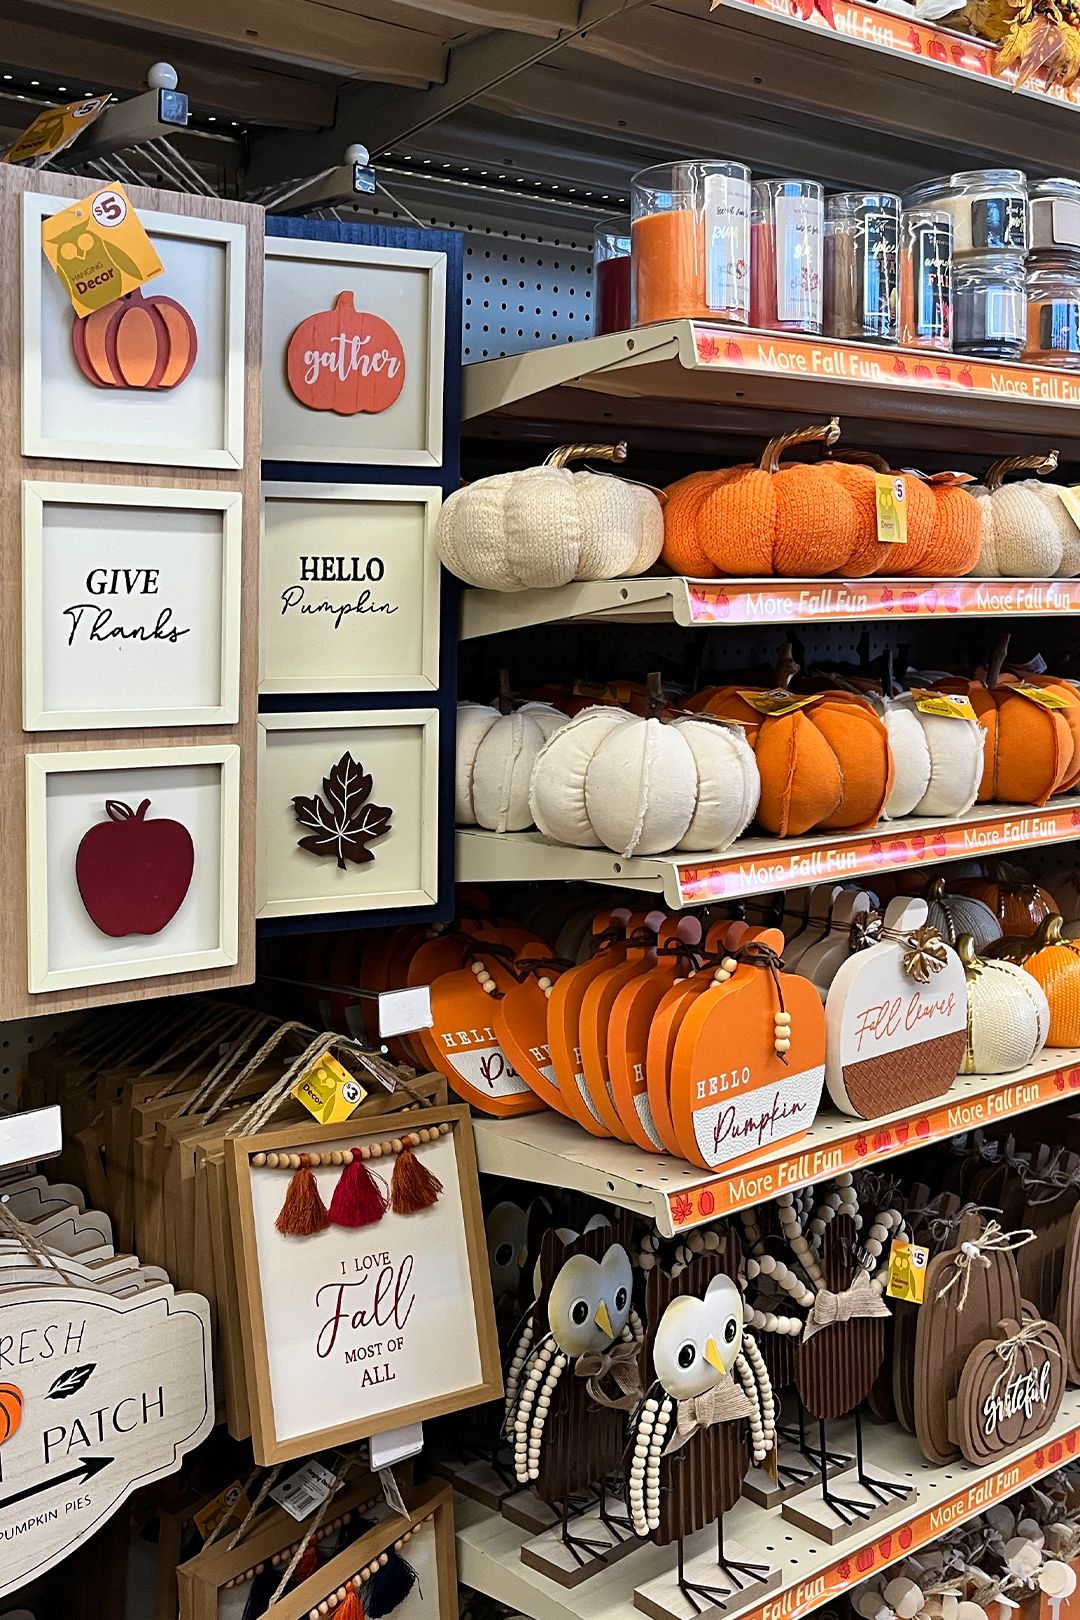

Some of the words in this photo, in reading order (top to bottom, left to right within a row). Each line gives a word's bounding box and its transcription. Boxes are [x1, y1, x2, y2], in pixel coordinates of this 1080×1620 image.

[834, 10, 858, 36] all
[863, 17, 894, 47] Fun
[94, 196, 122, 220] $5
[71, 261, 104, 282] HANGING
[75, 268, 115, 295] Decor
[304, 333, 400, 385] gather
[757, 344, 807, 371] More
[811, 350, 845, 374] Fall
[850, 356, 881, 378] Fun
[990, 373, 1029, 397] More
[1032, 377, 1058, 399] Fall
[86, 569, 160, 595] GIVE
[300, 556, 385, 582] HELLO
[280, 585, 399, 630] Pumpkin
[746, 592, 792, 615] More
[798, 590, 831, 614] Fall
[836, 590, 868, 613] Fun
[976, 589, 1013, 610] More
[1016, 588, 1043, 609] Fall
[1046, 588, 1070, 611] Fun
[63, 604, 191, 647] Thanks
[963, 829, 1000, 850] More
[1003, 822, 1031, 843] Fall
[1033, 818, 1056, 839] Fun
[738, 864, 785, 888] More
[789, 855, 822, 879] Fall
[827, 850, 857, 871] Fun
[441, 1027, 497, 1048] HELL
[855, 997, 902, 1051] Fall
[302, 1083, 324, 1106] Decor
[346, 1083, 359, 1101] $3
[696, 1066, 750, 1100] HELLO
[947, 1104, 984, 1127] More
[987, 1092, 1014, 1117] Fall
[1016, 1083, 1040, 1106] Fun
[713, 1091, 807, 1154] Pumpkin
[728, 1171, 773, 1204] More
[777, 1155, 809, 1187] Fall
[813, 1147, 843, 1173] Fun
[340, 1261, 347, 1275] I
[354, 1252, 391, 1272] LOVE
[316, 1255, 416, 1359] Fall
[0, 1320, 86, 1370] RESH
[344, 1343, 383, 1364] MOST
[387, 1336, 404, 1352] OF
[361, 1363, 396, 1388] ALL
[983, 1360, 1050, 1436] grateful
[43, 1386, 164, 1465] PATCH
[65, 1494, 92, 1514] PIES
[929, 1500, 965, 1531] More
[967, 1482, 994, 1509] Fall
[996, 1466, 1019, 1493] Fun
[762, 1590, 793, 1620] Fall
[796, 1575, 825, 1607] Fun
